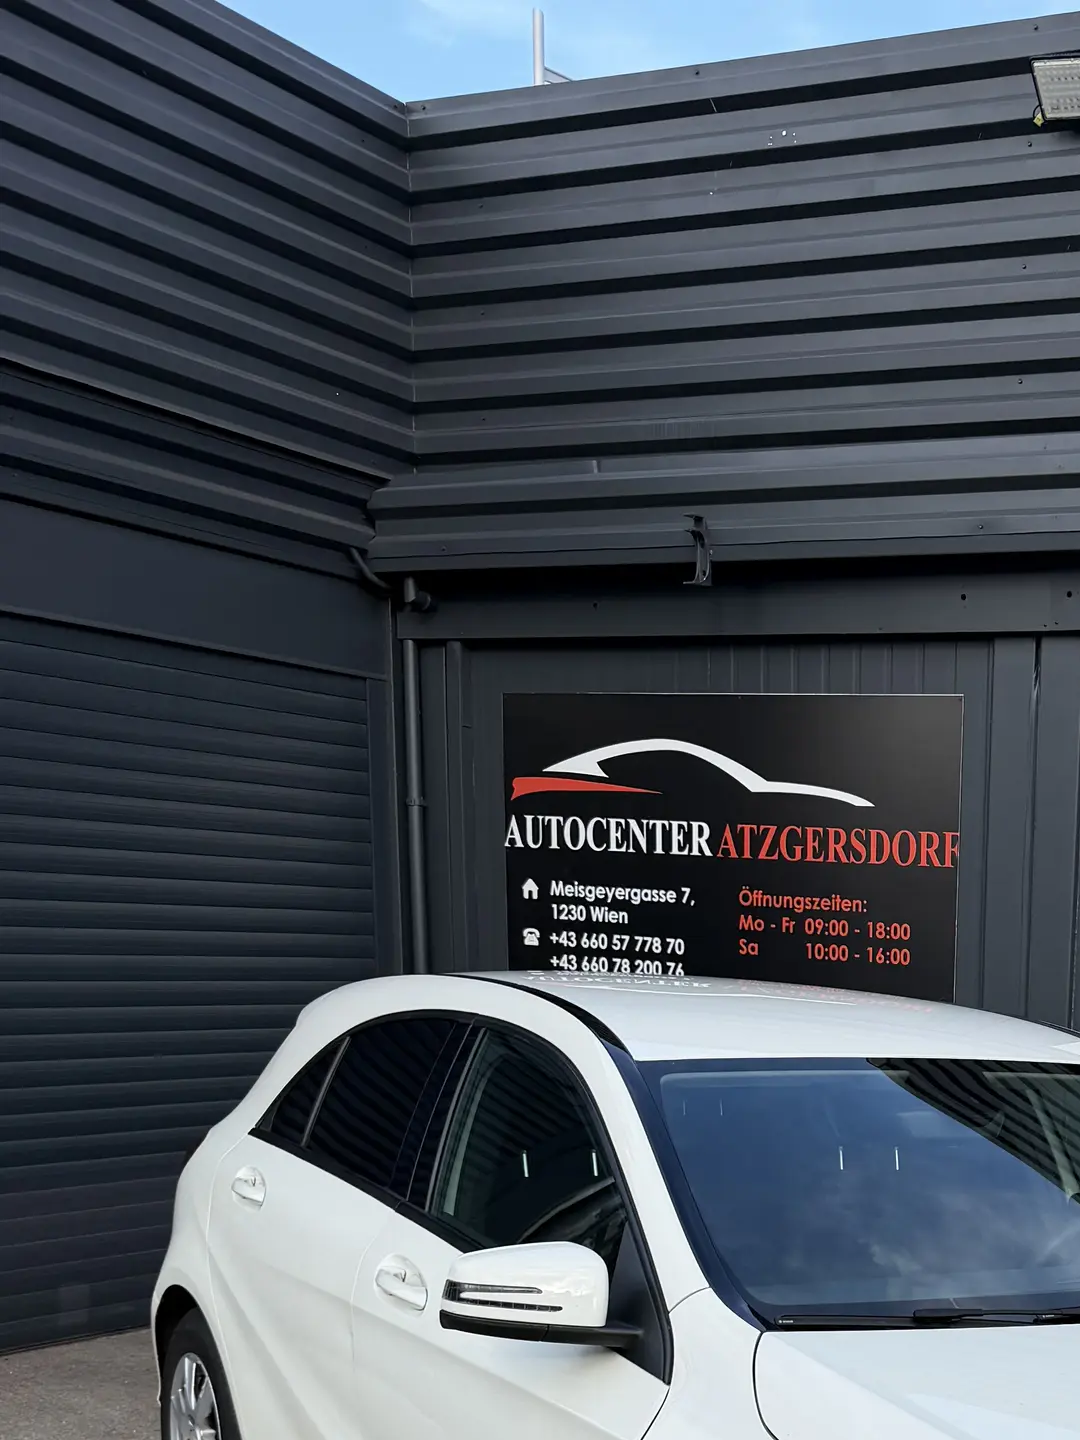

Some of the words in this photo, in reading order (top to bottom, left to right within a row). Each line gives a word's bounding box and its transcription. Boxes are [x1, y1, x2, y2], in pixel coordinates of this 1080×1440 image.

[504, 815, 713, 857] AUTOCENTER
[717, 823, 960, 868] ATZGERSDORF
[549, 880, 677, 905] Meisgeyergasse
[680, 887, 695, 907] 7,
[738, 886, 867, 913] Öffnungszeiten:
[550, 903, 587, 923] 1230
[589, 905, 629, 924] Wien
[738, 914, 765, 932] Mo
[782, 917, 796, 934] Fr
[803, 918, 849, 937] 09:00
[867, 921, 911, 941] 18:00
[549, 930, 578, 948] +43
[580, 932, 608, 950] 660
[611, 934, 631, 951] 57
[634, 936, 662, 954] 778
[665, 937, 685, 956] 70
[739, 938, 759, 956] Sa
[805, 943, 849, 962] 10:00
[866, 947, 911, 966] 16:00
[549, 953, 578, 971] +43
[581, 955, 609, 972] 660
[611, 957, 631, 973] 78
[634, 959, 663, 975] 200
[665, 961, 685, 977] 76
